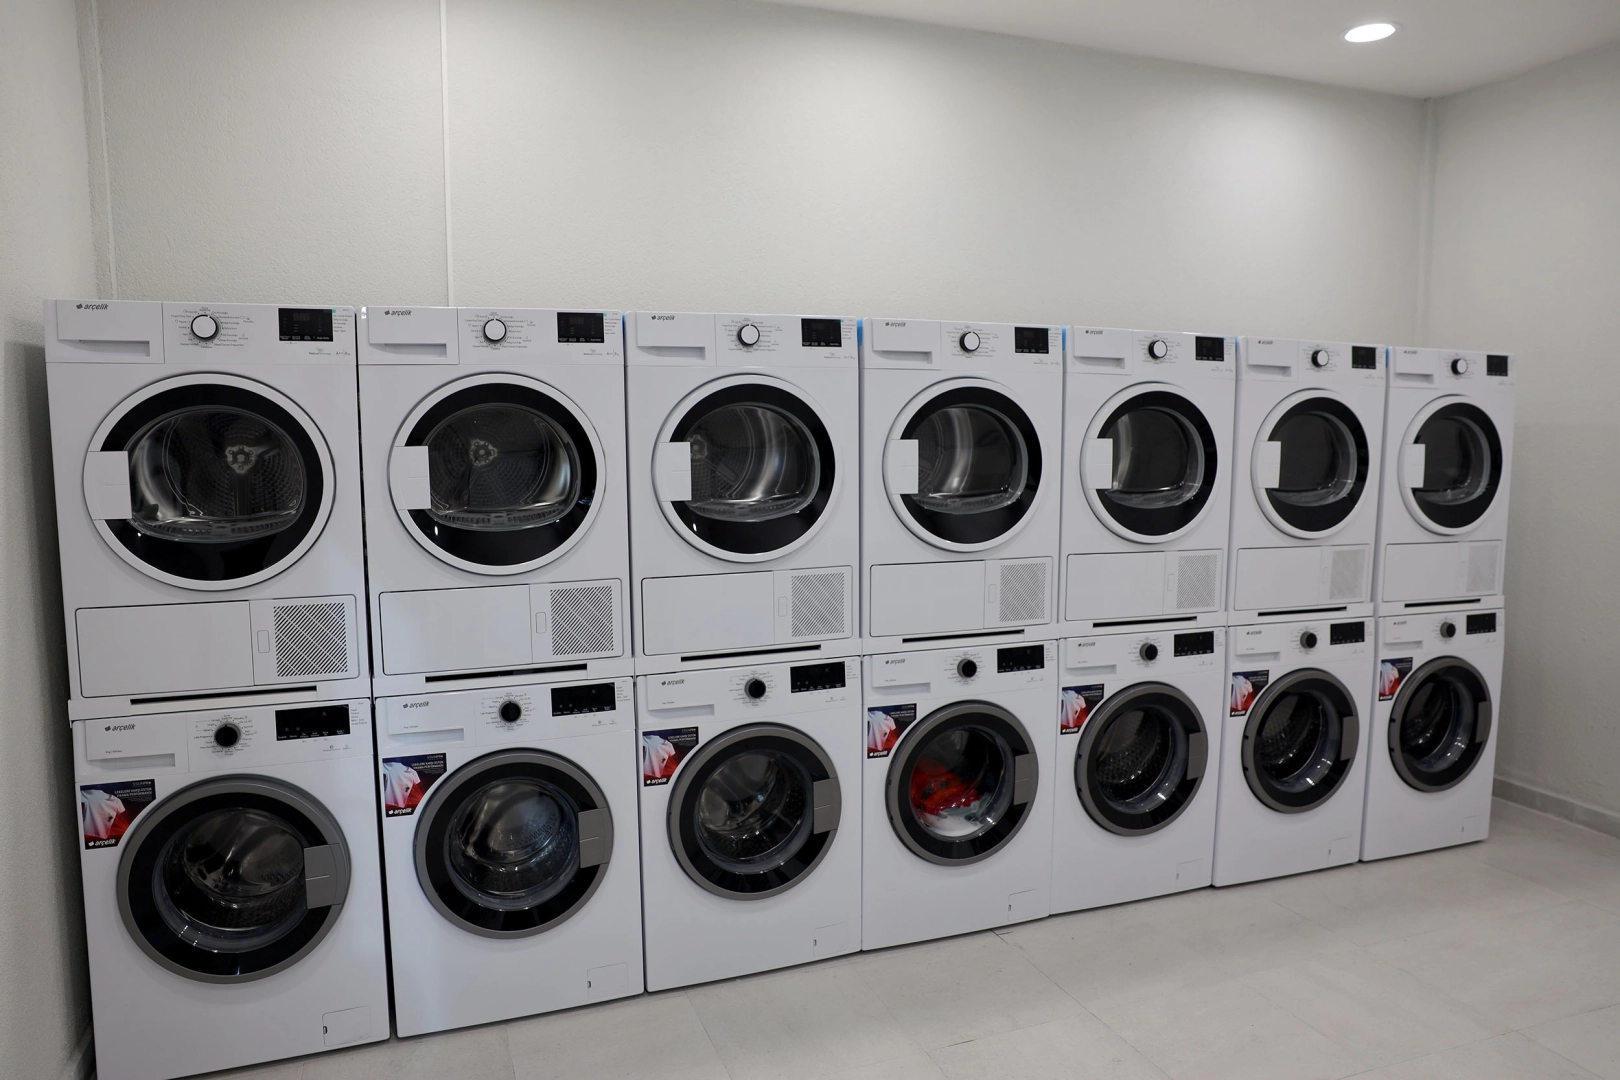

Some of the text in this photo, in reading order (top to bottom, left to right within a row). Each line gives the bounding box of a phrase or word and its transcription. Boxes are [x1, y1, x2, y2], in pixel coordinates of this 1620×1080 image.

[84, 303, 109, 311] arçelik
[391, 309, 412, 317] arçelik
[409, 701, 430, 709] arçelik
[112, 723, 136, 732] arçelik
[95, 838, 116, 846] arçelik
